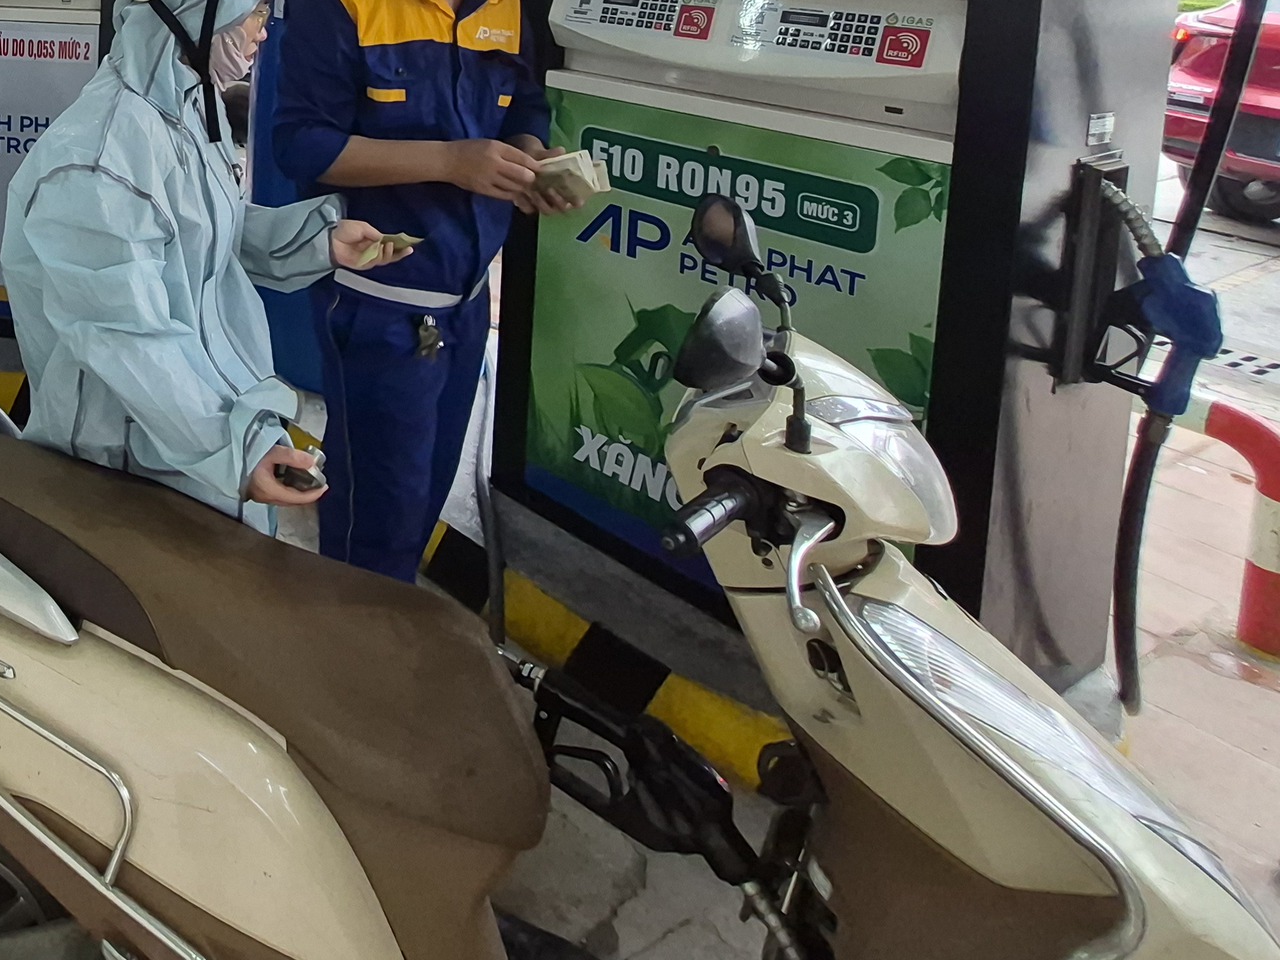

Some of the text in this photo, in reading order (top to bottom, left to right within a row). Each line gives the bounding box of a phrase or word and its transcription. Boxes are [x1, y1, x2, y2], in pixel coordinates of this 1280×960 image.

[901, 15, 934, 27] IGAS
[12, 38, 24, 57] DO
[28, 39, 55, 60] 0,05S
[58, 37, 81, 60] MỨC
[83, 42, 90, 61] 2
[888, 49, 908, 58] RFID
[19, 115, 50, 133] PH
[591, 139, 854, 226] E10 RON95 MỨC 3
[766, 247, 866, 297] PHAT
